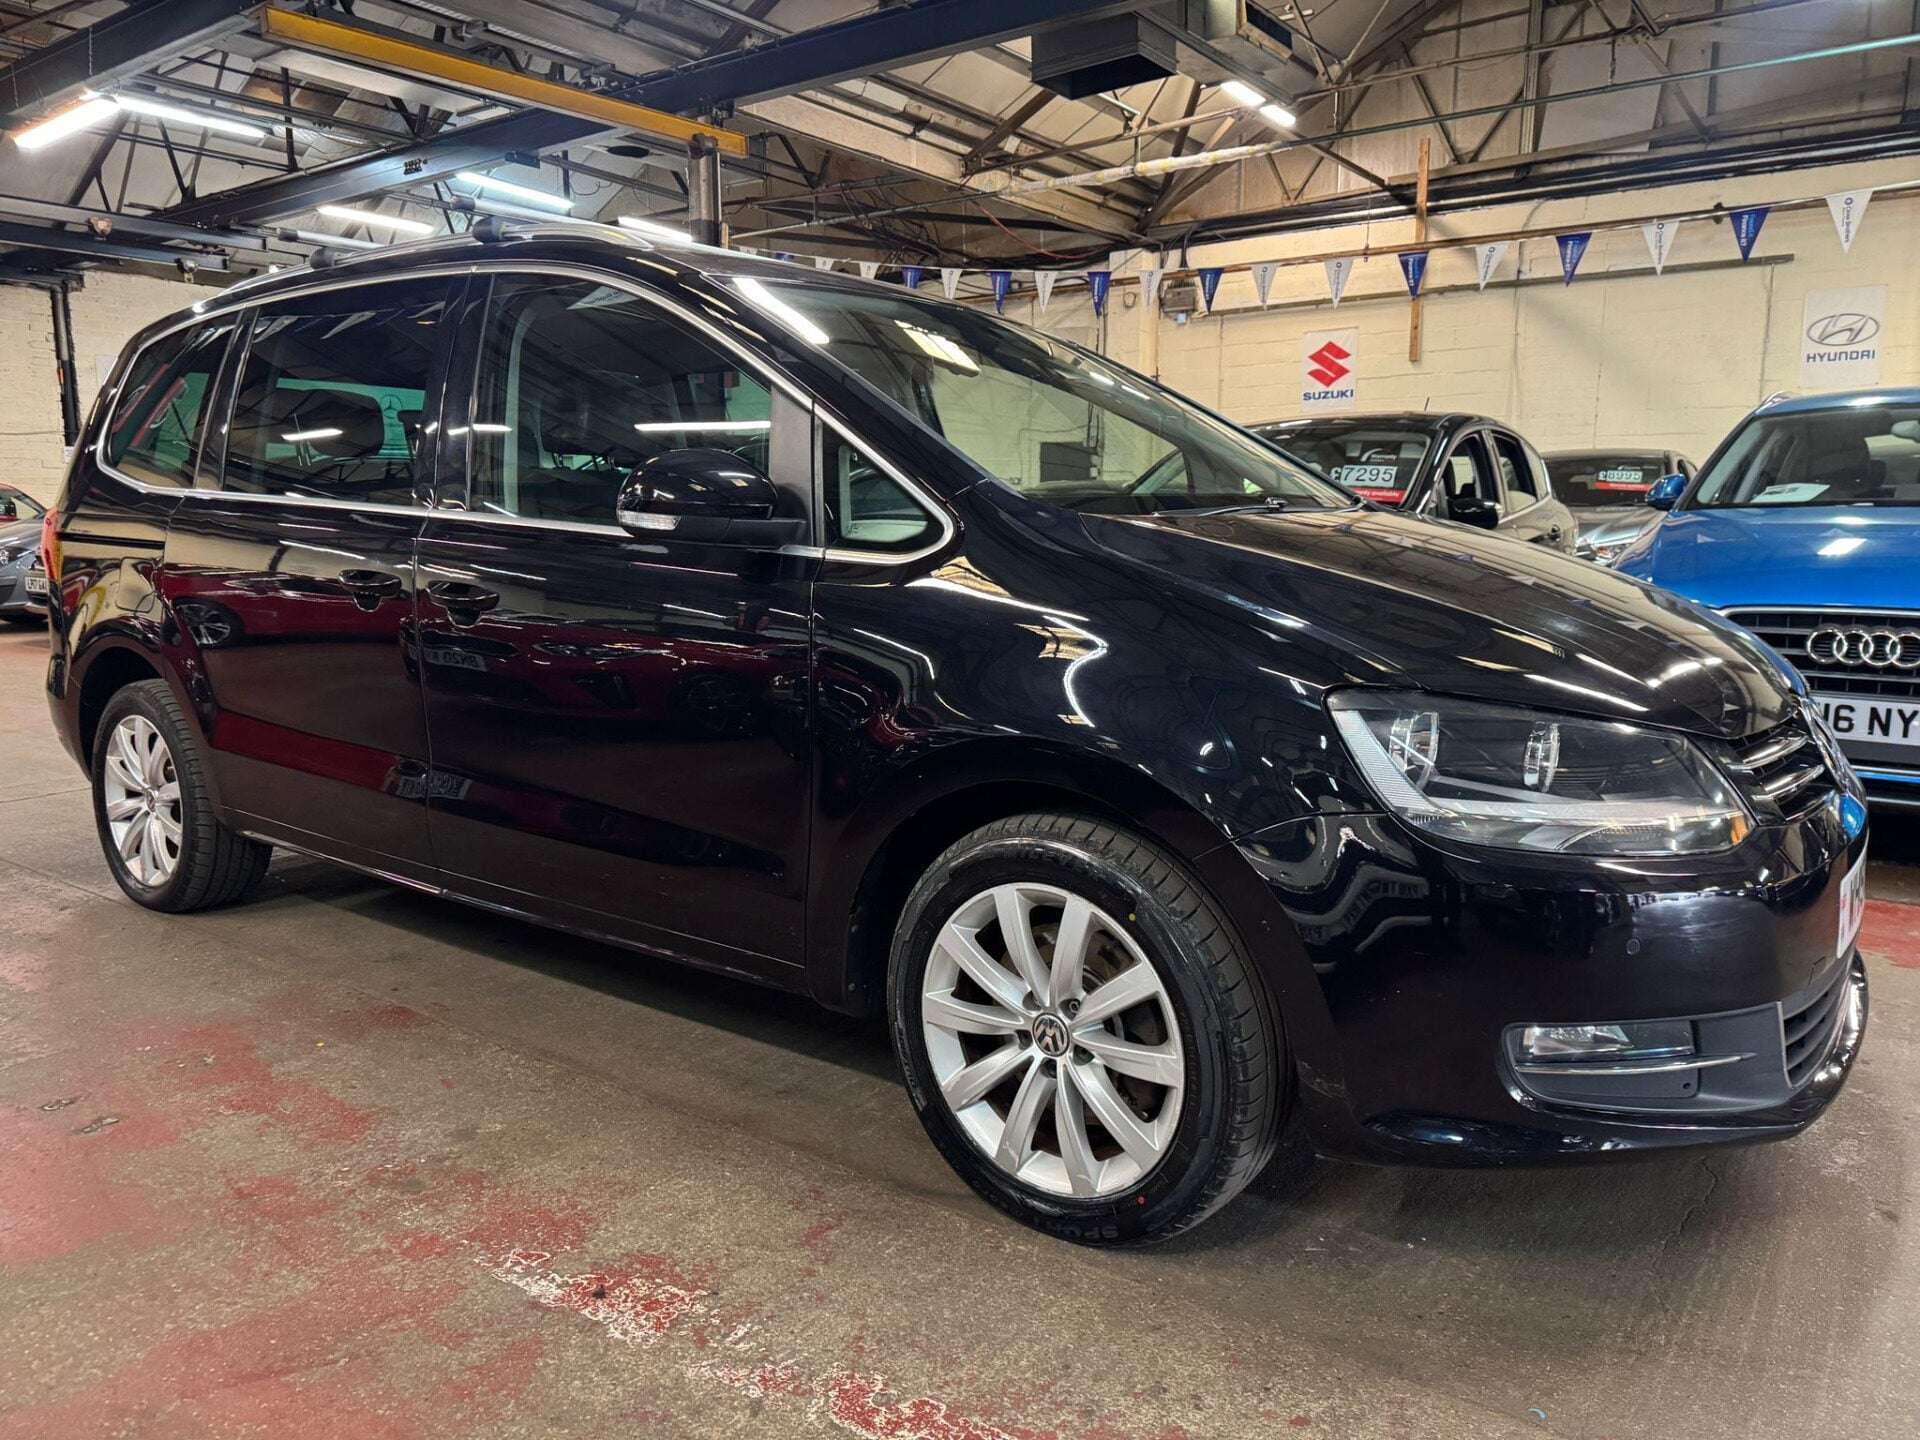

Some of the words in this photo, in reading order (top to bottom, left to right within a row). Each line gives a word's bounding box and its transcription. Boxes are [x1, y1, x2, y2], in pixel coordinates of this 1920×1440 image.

[1806, 350, 1876, 363] HYUNDAI
[1303, 389, 1354, 401] SUZUKI
[1867, 706, 1919, 738] NY
